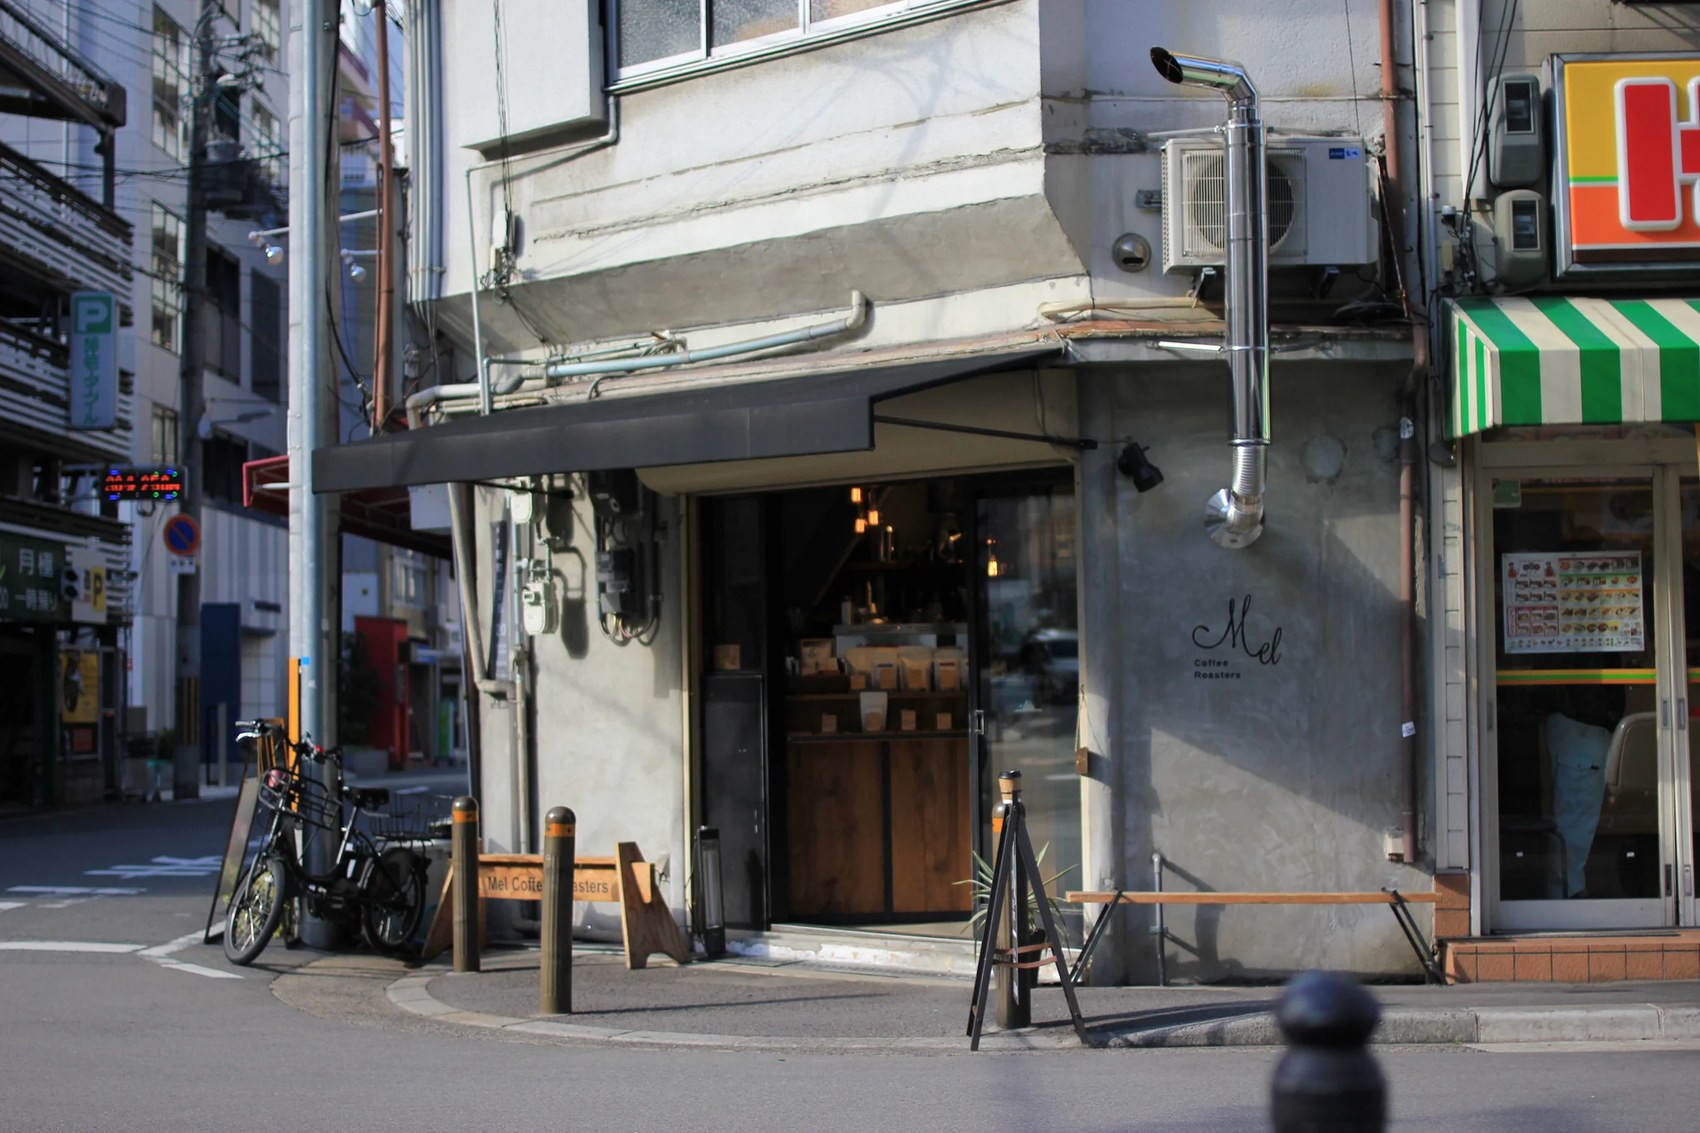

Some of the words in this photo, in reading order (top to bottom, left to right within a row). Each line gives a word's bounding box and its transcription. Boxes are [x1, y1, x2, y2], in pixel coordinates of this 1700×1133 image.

[78, 302, 107, 331] P
[1192, 594, 1282, 665] Mel
[1194, 659, 1229, 667] Coffee
[1194, 671, 1241, 679] Roasters
[488, 876, 508, 891] Mel
[512, 876, 543, 892] Coffe
[573, 880, 609, 894] asters
